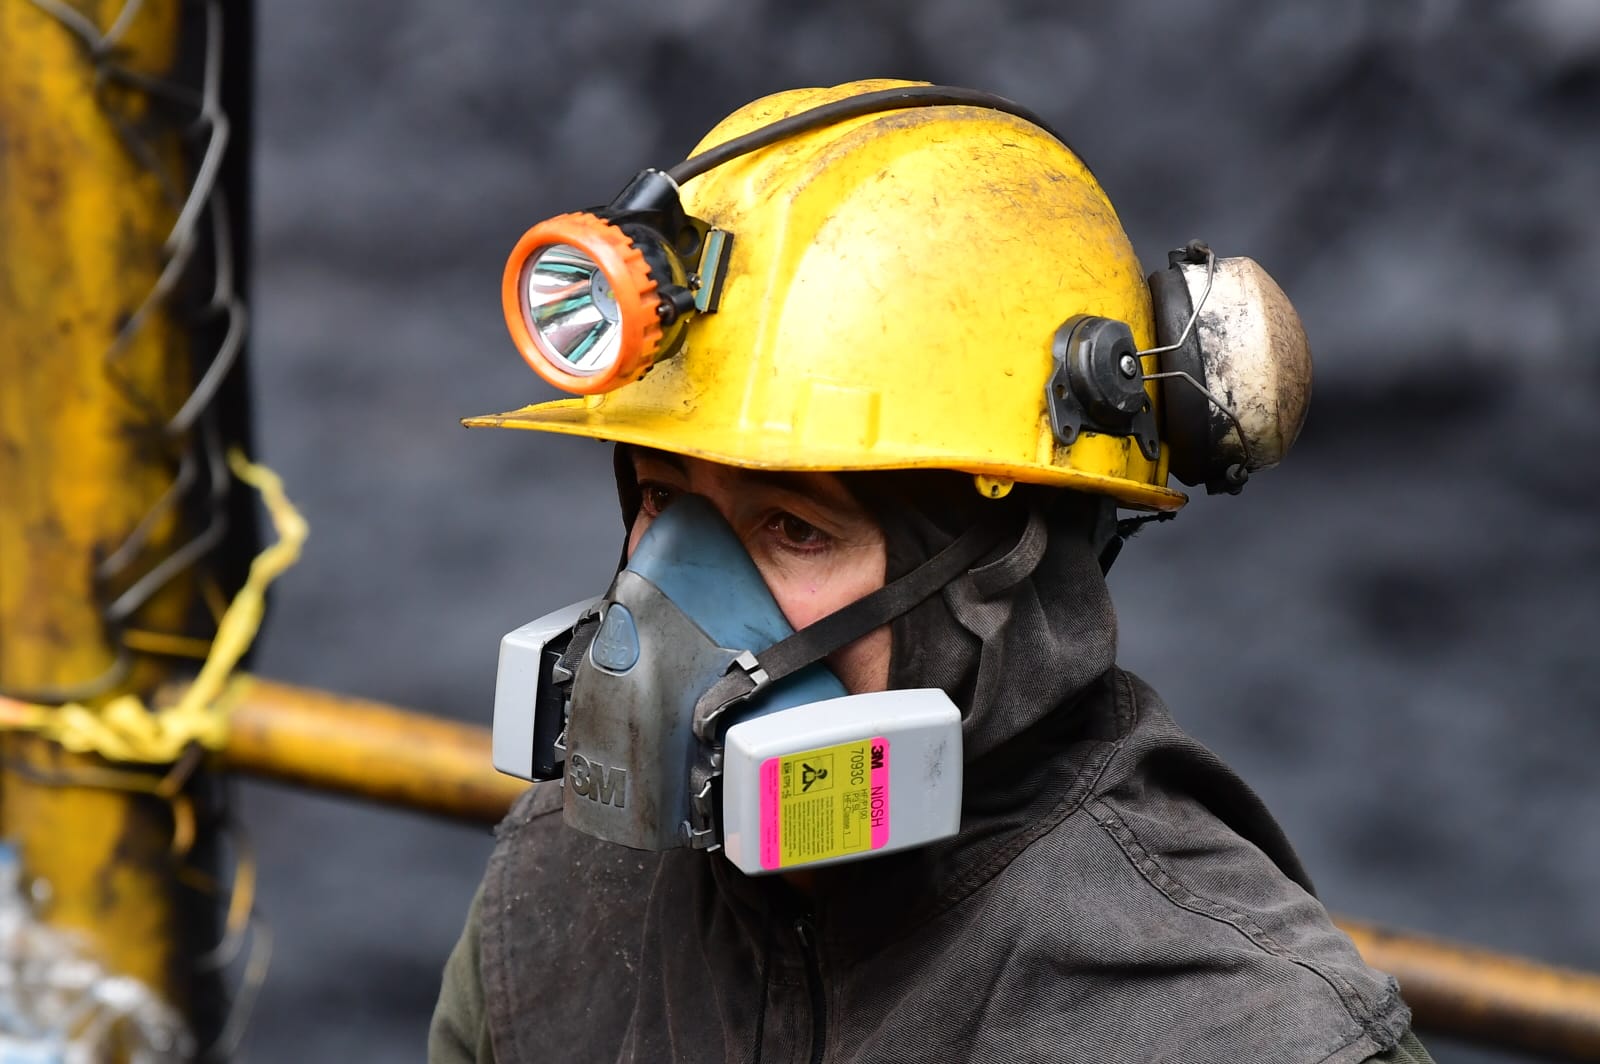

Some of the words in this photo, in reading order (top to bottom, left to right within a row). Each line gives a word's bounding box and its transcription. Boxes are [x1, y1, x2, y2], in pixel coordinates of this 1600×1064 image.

[850, 747, 864, 785] 7093C
[871, 745, 884, 769] 3M
[570, 753, 626, 808] 3M
[871, 785, 884, 827] NIOSH
